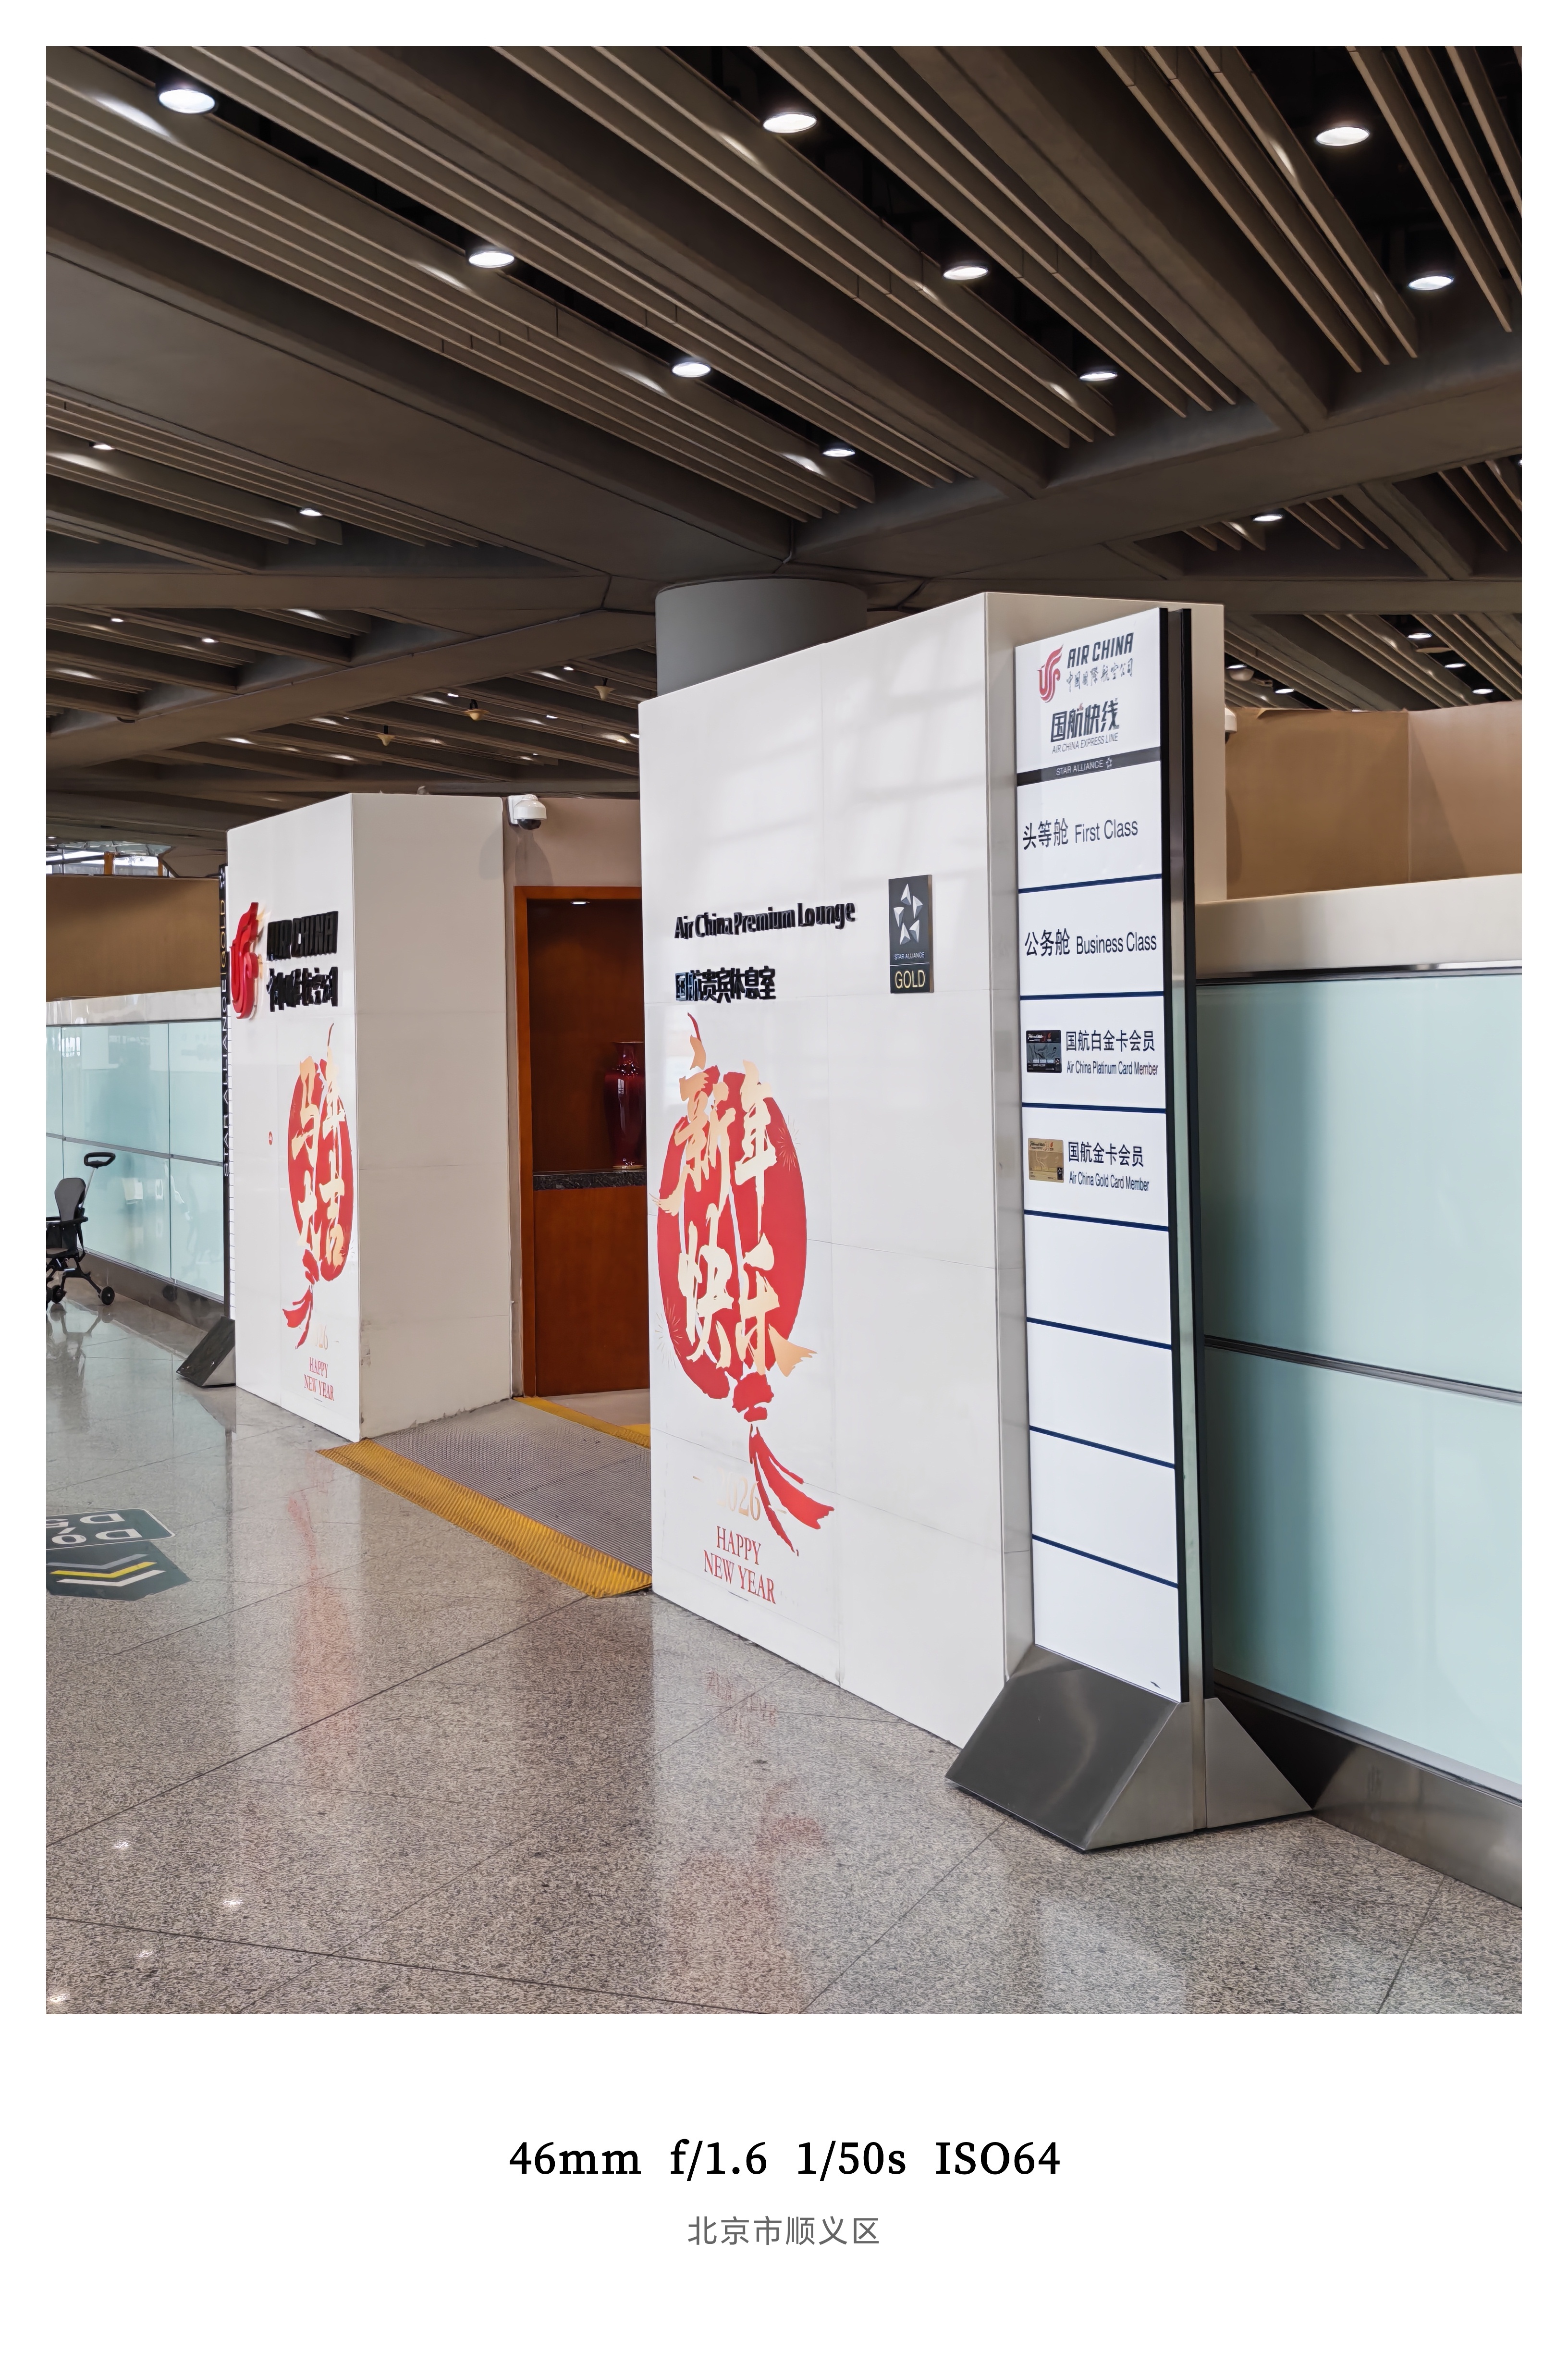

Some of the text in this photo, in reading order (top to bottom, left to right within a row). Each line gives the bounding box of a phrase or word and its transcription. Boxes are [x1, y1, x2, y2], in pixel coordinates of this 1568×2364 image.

[1067, 632, 1134, 668] AIR CHINA
[1051, 698, 1119, 743] 国航快线
[1052, 732, 1119, 754] AIR CHINA EXPRESS LINE
[1056, 760, 1104, 776] STAR ALLIANCE
[1023, 818, 1139, 850] 头等舱 First Class
[674, 903, 856, 939] Air China Premium Lounge
[1025, 928, 1157, 957] 公务舱 Business Class
[895, 970, 926, 989] GOLD
[1066, 1030, 1155, 1052] 国航白金卡会员
[1076, 1060, 1091, 1074] China
[1093, 1060, 1116, 1074] Platinum
[1118, 1060, 1132, 1075] Card
[1134, 1061, 1158, 1075] Member
[1068, 1142, 1144, 1167] 国航金卡会员
[1078, 1171, 1094, 1185] China
[1095, 1173, 1108, 1187] Gold
[1111, 1174, 1124, 1189] Card
[1126, 1176, 1150, 1192] Member
[309, 1357, 328, 1378] HAPPY
[304, 1374, 334, 1401] NEW YEAR
[716, 1526, 761, 1565] HAPPY
[703, 1549, 776, 1604] NEW YEAR
